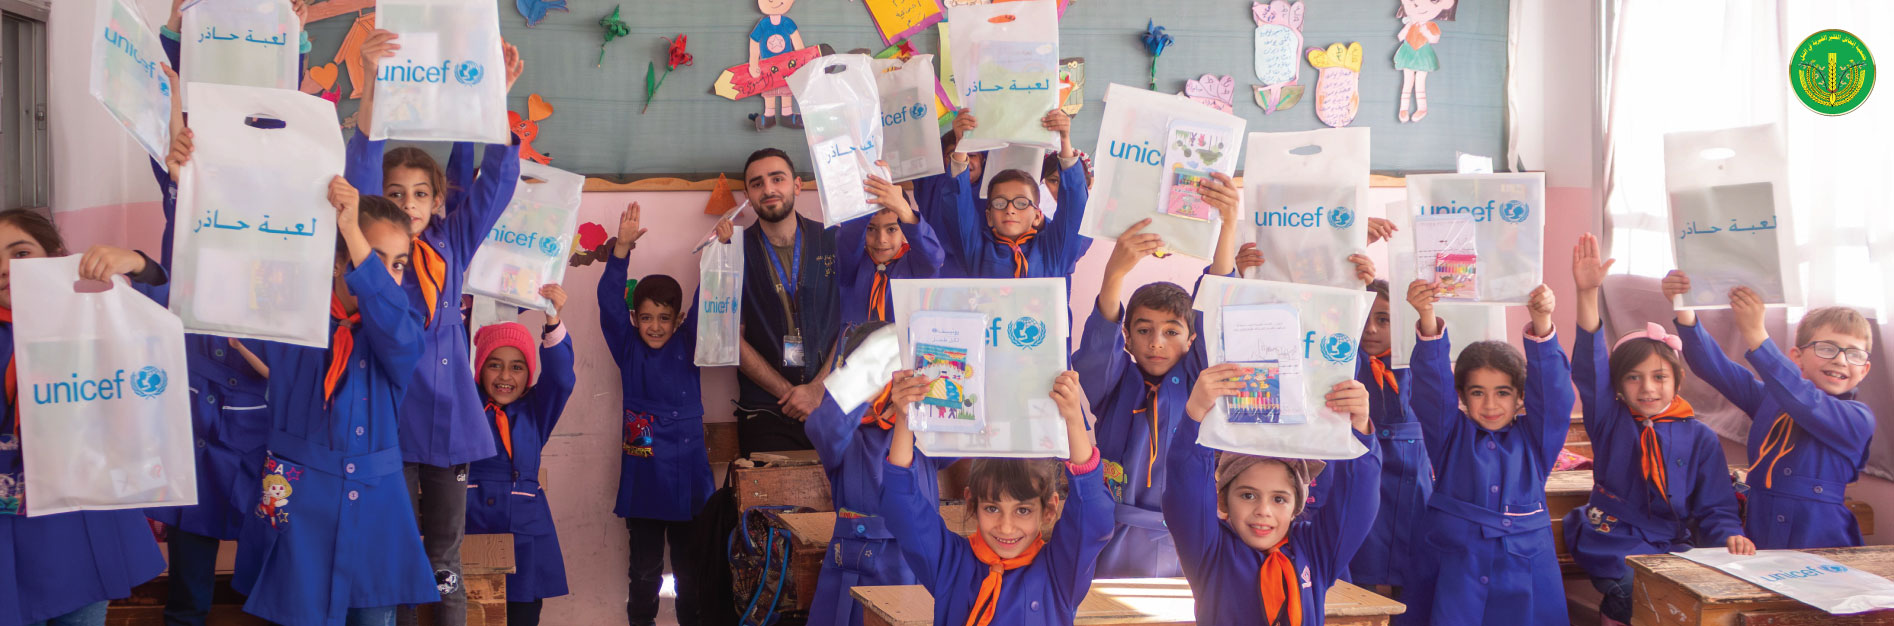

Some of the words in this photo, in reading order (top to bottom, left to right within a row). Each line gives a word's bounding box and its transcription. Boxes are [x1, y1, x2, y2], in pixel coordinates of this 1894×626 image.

[198, 26, 240, 43] حاذر
[245, 30, 286, 48] لعبة
[376, 59, 451, 84] unicef
[966, 80, 1004, 97] حاذر
[1009, 78, 1050, 95] لعبة
[881, 105, 908, 128] icef
[1109, 139, 1165, 168] unic
[193, 210, 250, 234] حاذر
[258, 214, 317, 240] لعبة
[1254, 205, 1324, 228] unicef
[1728, 215, 1777, 235] لعبة
[486, 224, 538, 249] nicef
[1680, 221, 1722, 240] حاذر
[33, 369, 125, 405] unicef
[1760, 565, 1825, 583] unicef
